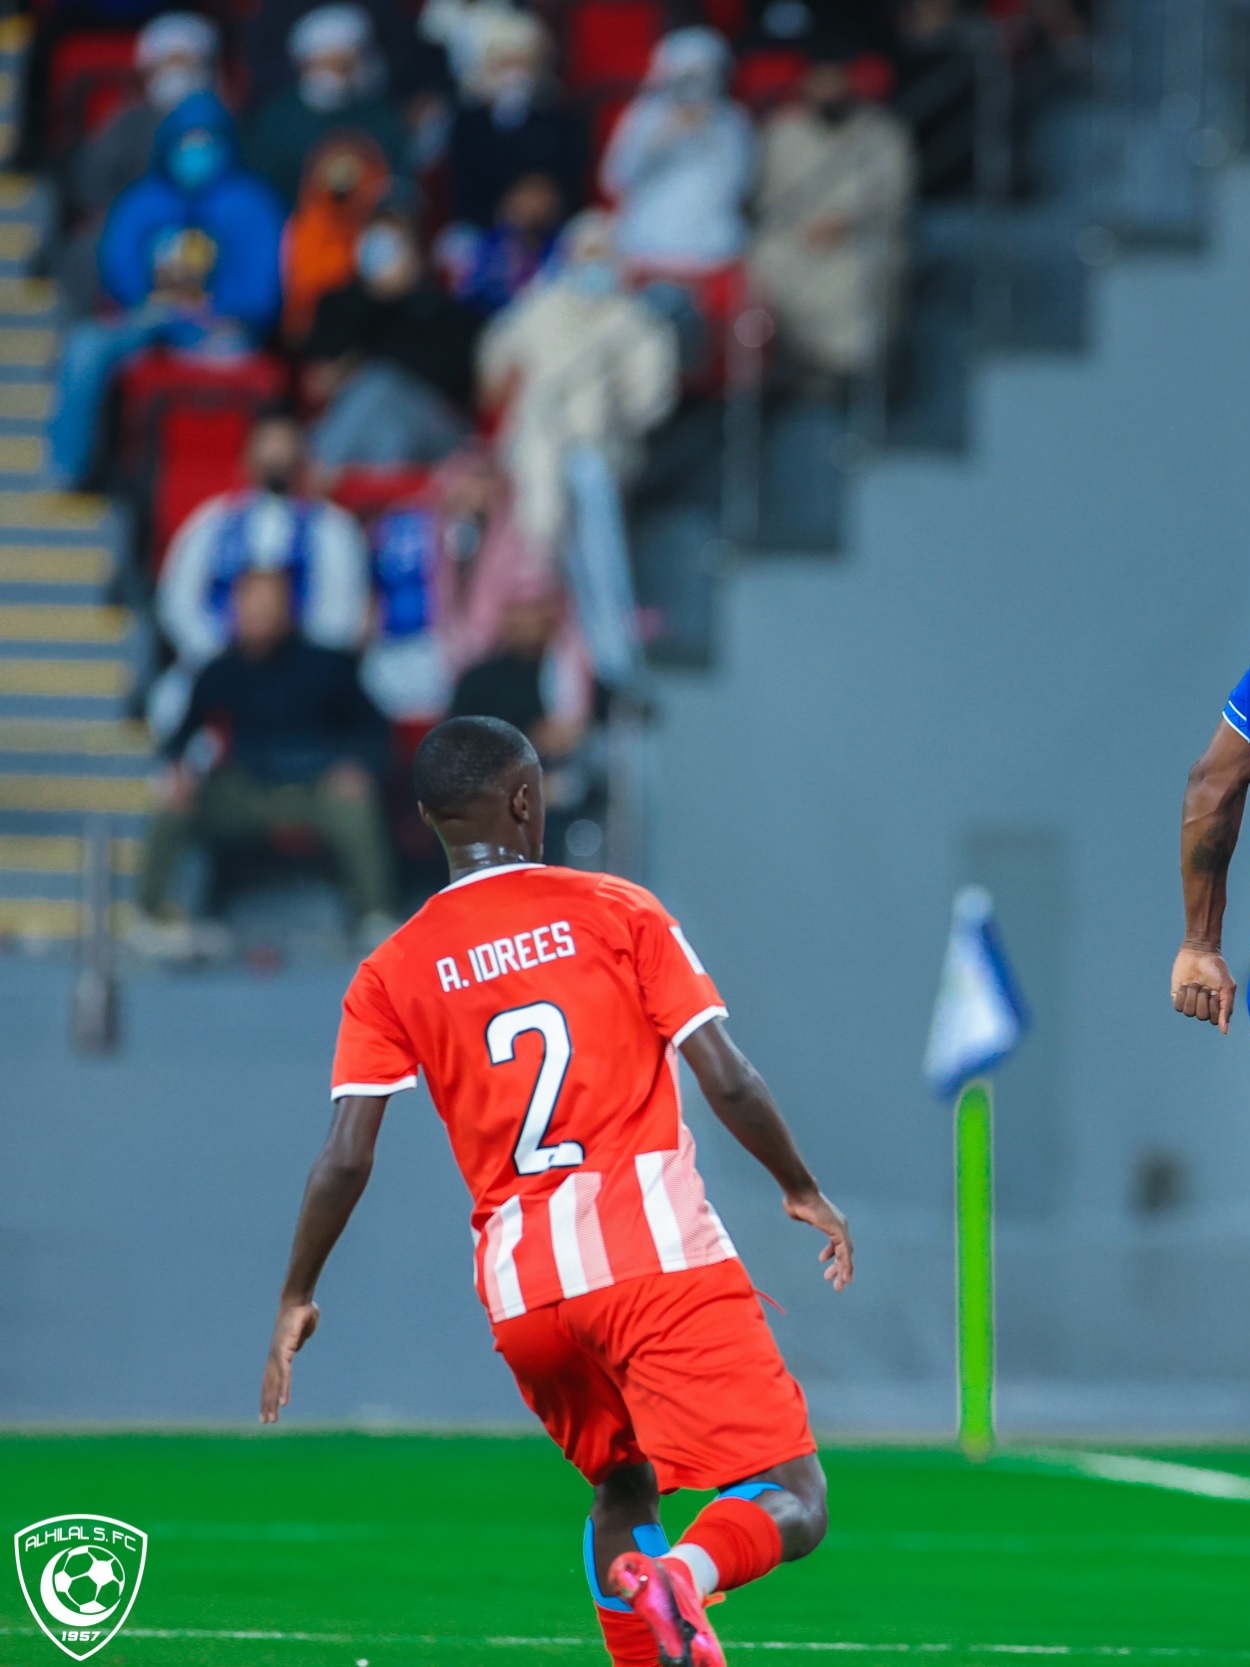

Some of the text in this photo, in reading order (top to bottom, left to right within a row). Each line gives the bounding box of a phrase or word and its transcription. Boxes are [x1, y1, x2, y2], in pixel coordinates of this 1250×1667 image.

[436, 920, 576, 992] A. IDREES
[484, 1000, 585, 1176] 2
